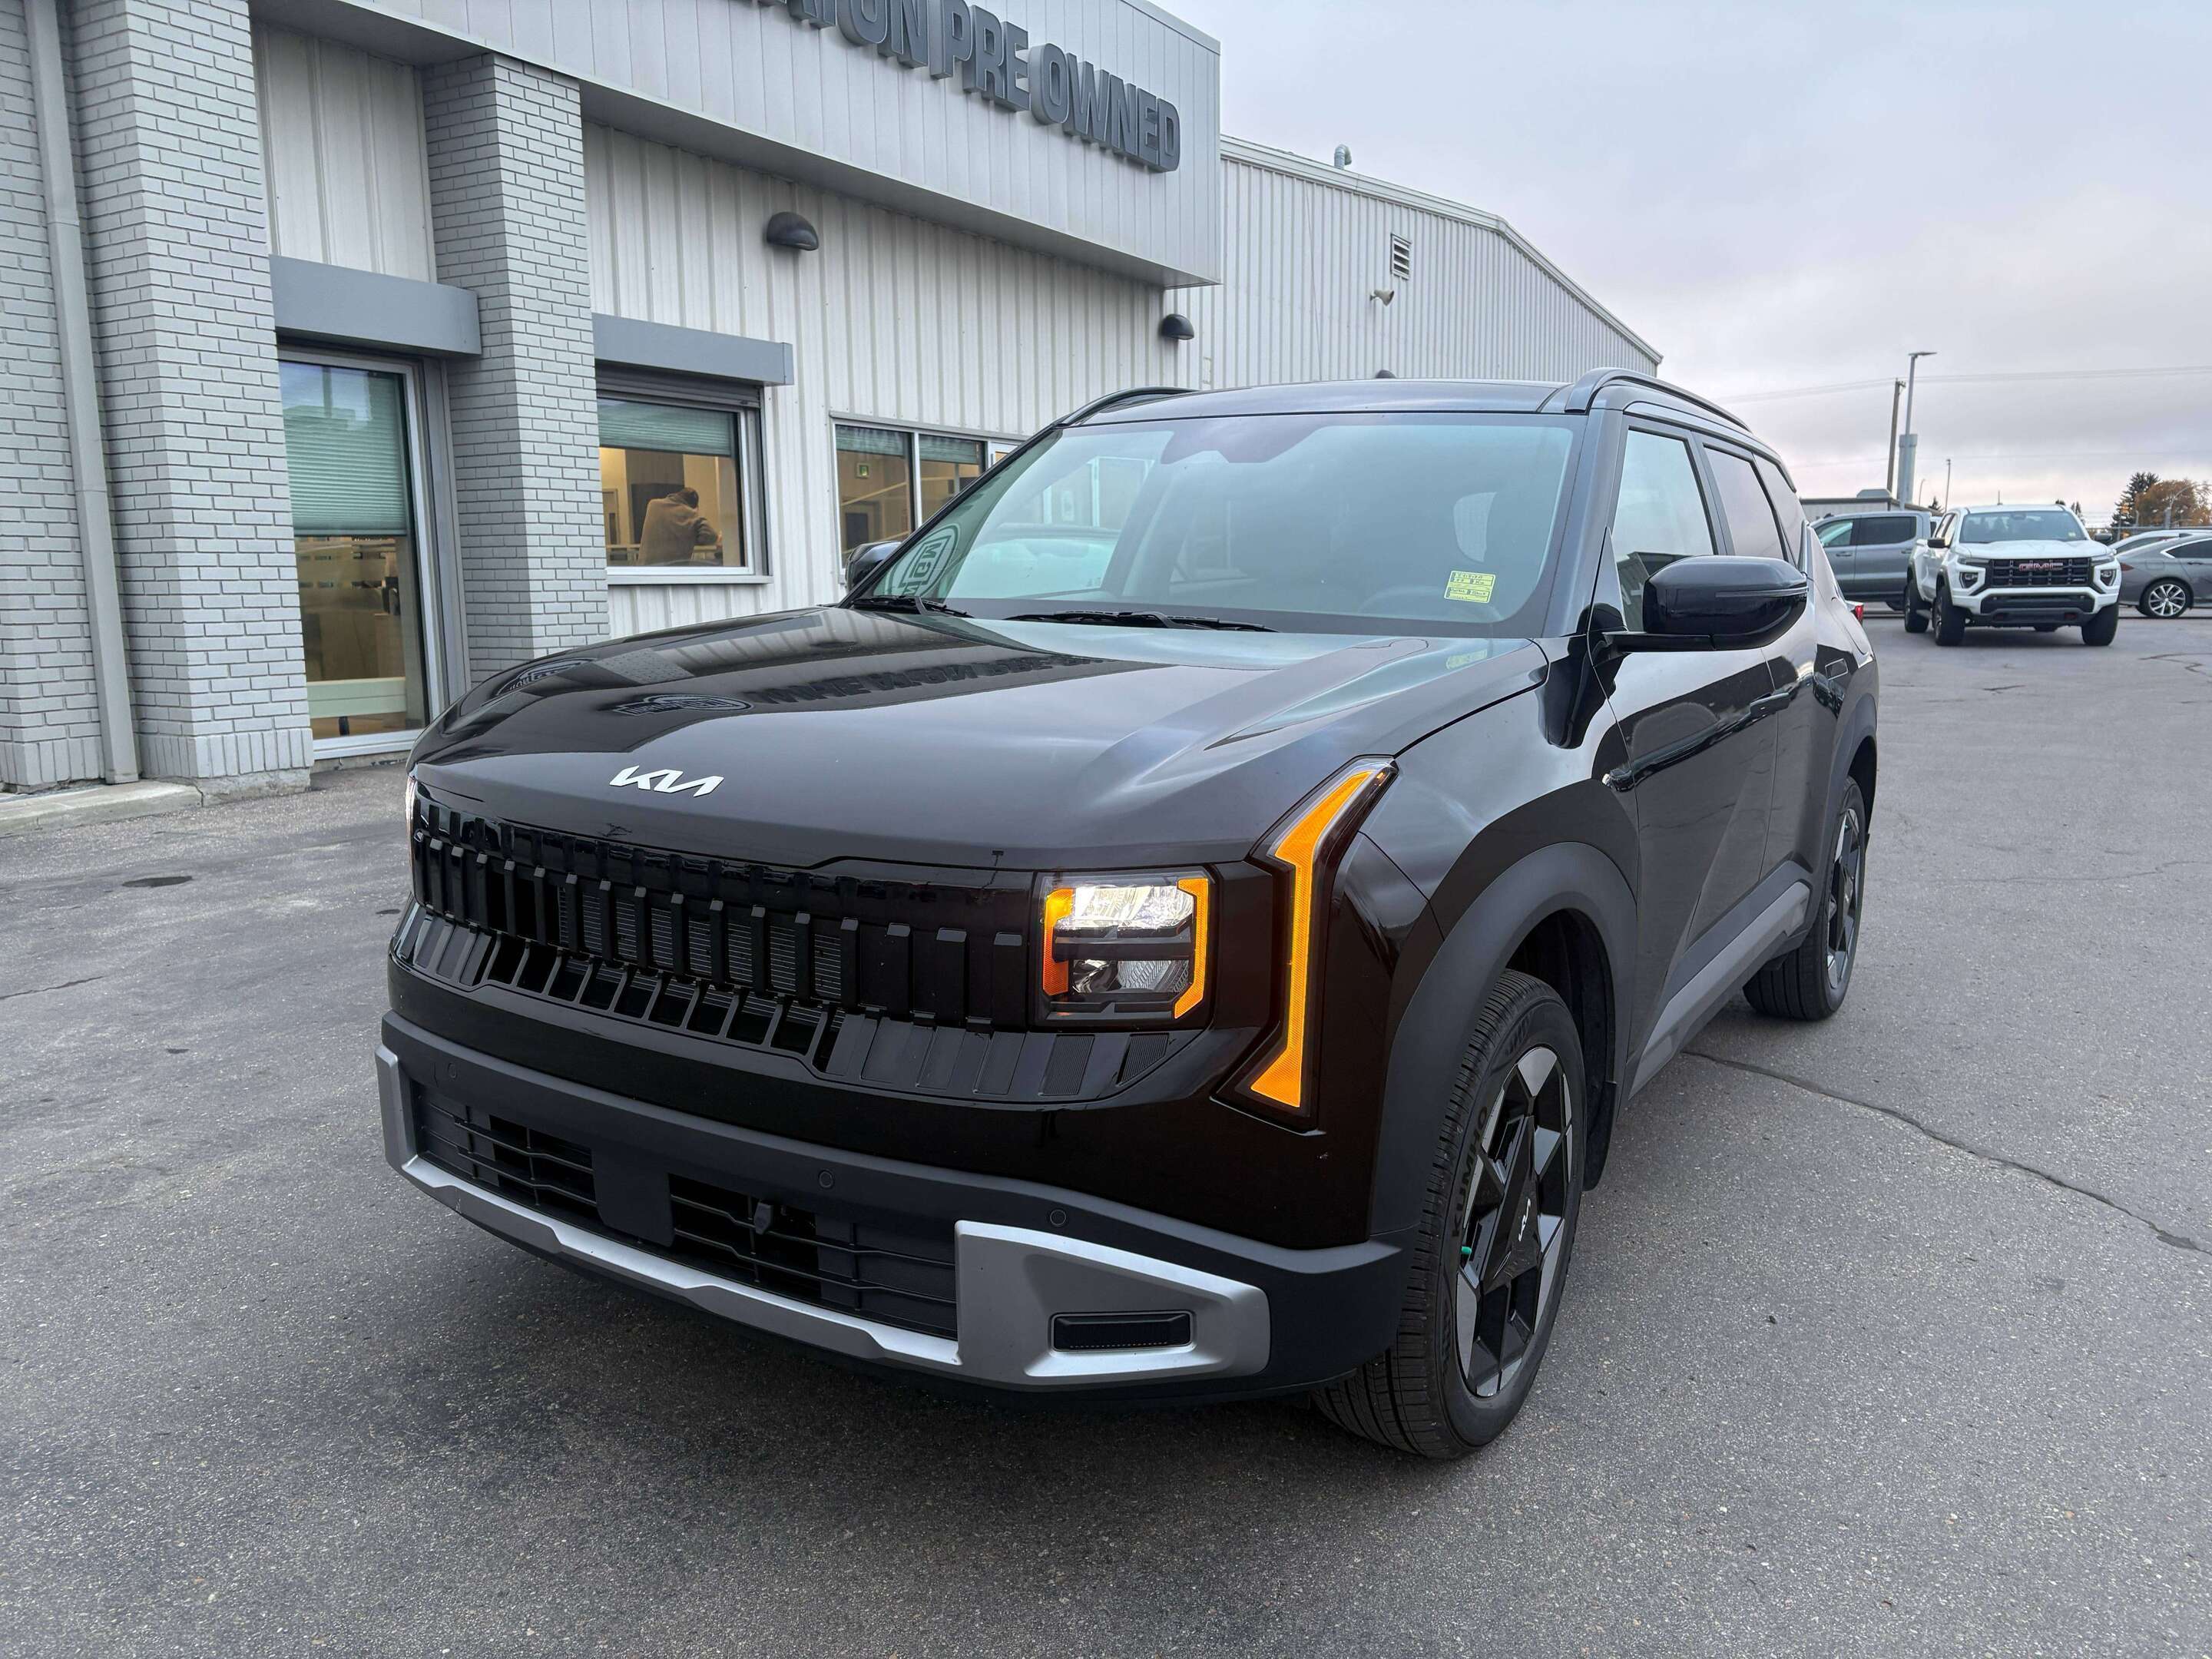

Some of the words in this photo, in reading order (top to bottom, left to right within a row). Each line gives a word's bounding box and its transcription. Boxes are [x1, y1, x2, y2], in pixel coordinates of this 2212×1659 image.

[929, 0, 1030, 111] PRE
[1029, 43, 1181, 172] OWNED
[2019, 561, 2063, 571] GMC
[609, 765, 725, 797] KIA
[1452, 1106, 1488, 1237] KUMHO
